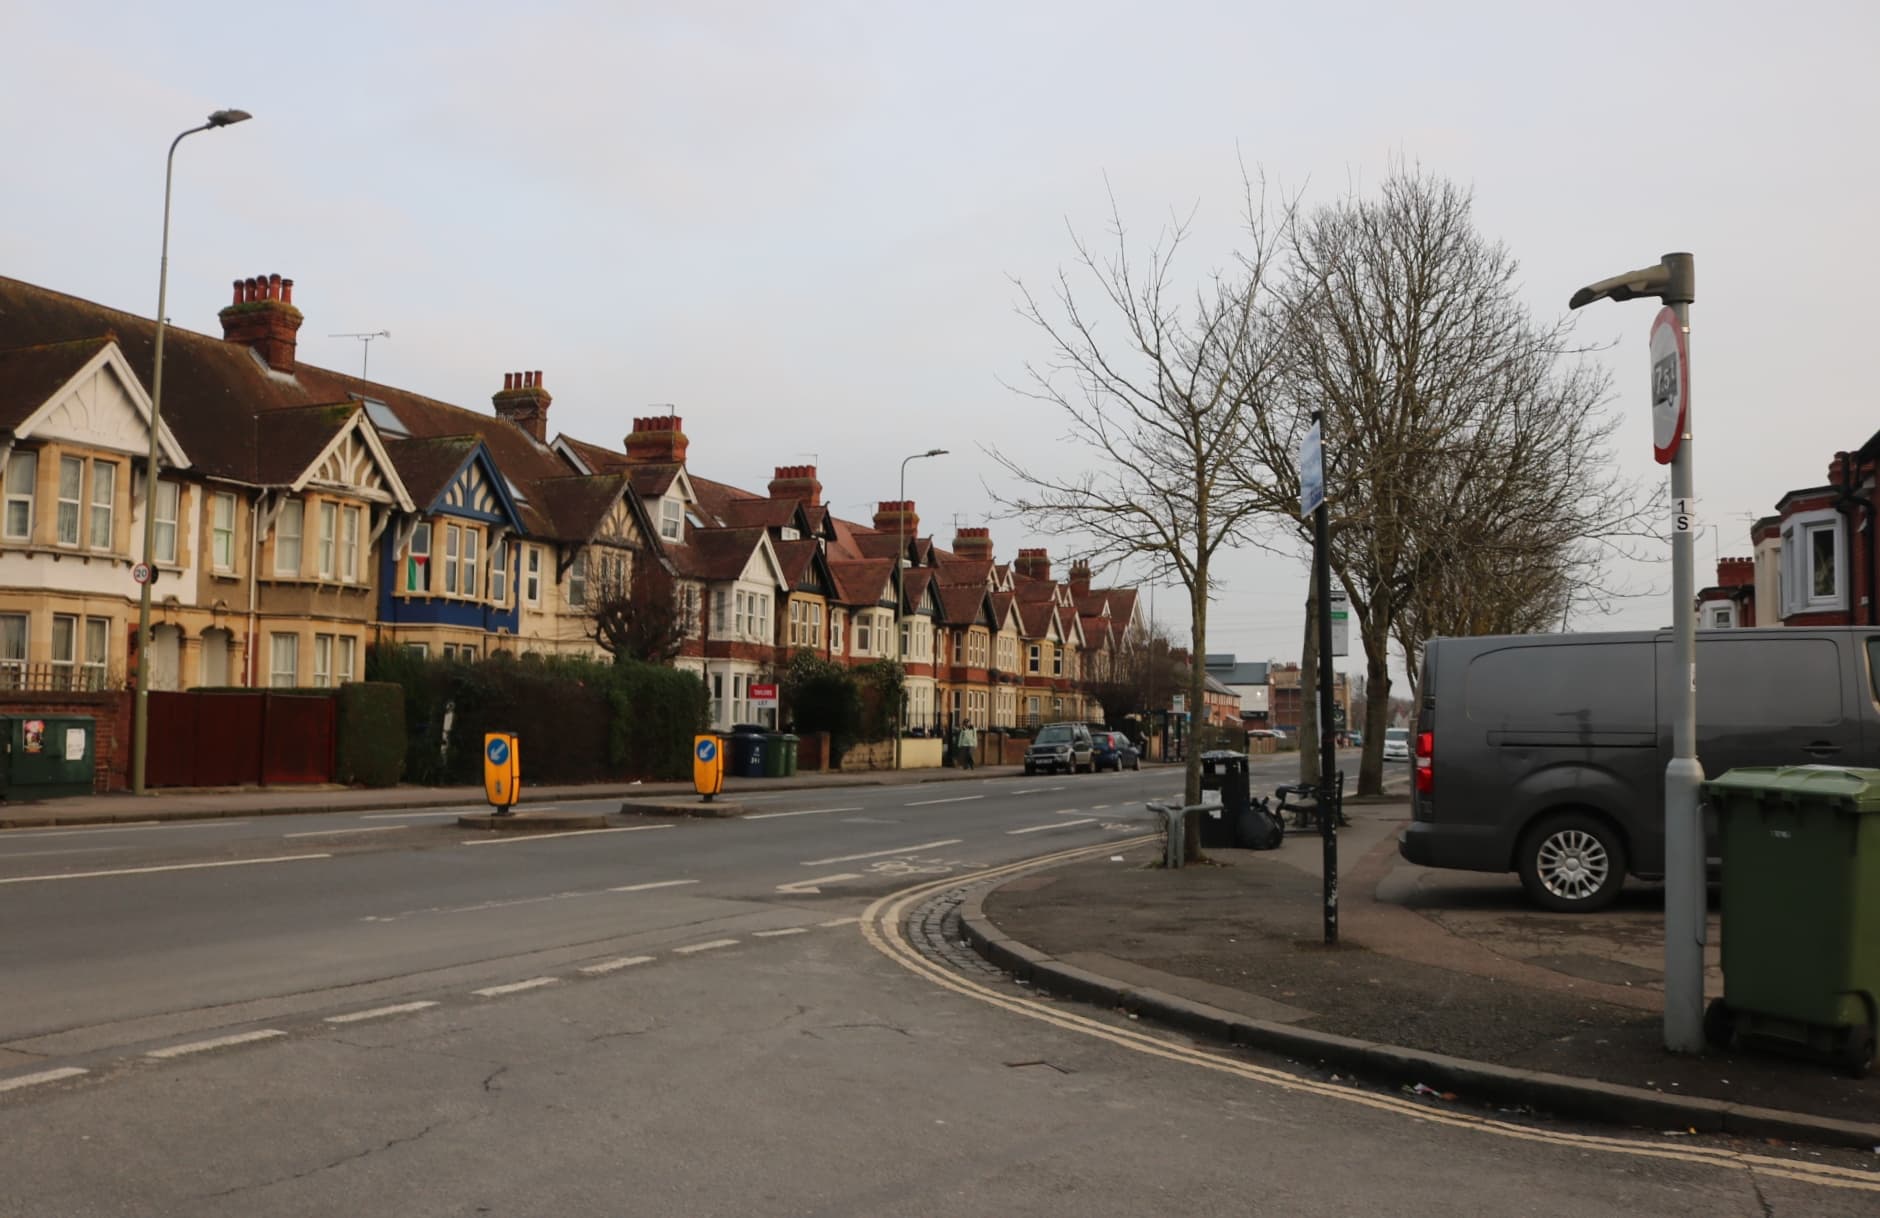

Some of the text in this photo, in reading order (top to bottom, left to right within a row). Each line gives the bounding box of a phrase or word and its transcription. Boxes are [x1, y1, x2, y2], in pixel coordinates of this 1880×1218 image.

[1677, 500, 1685, 513] 1
[1677, 516, 1688, 530] S
[136, 568, 147, 578] 20
